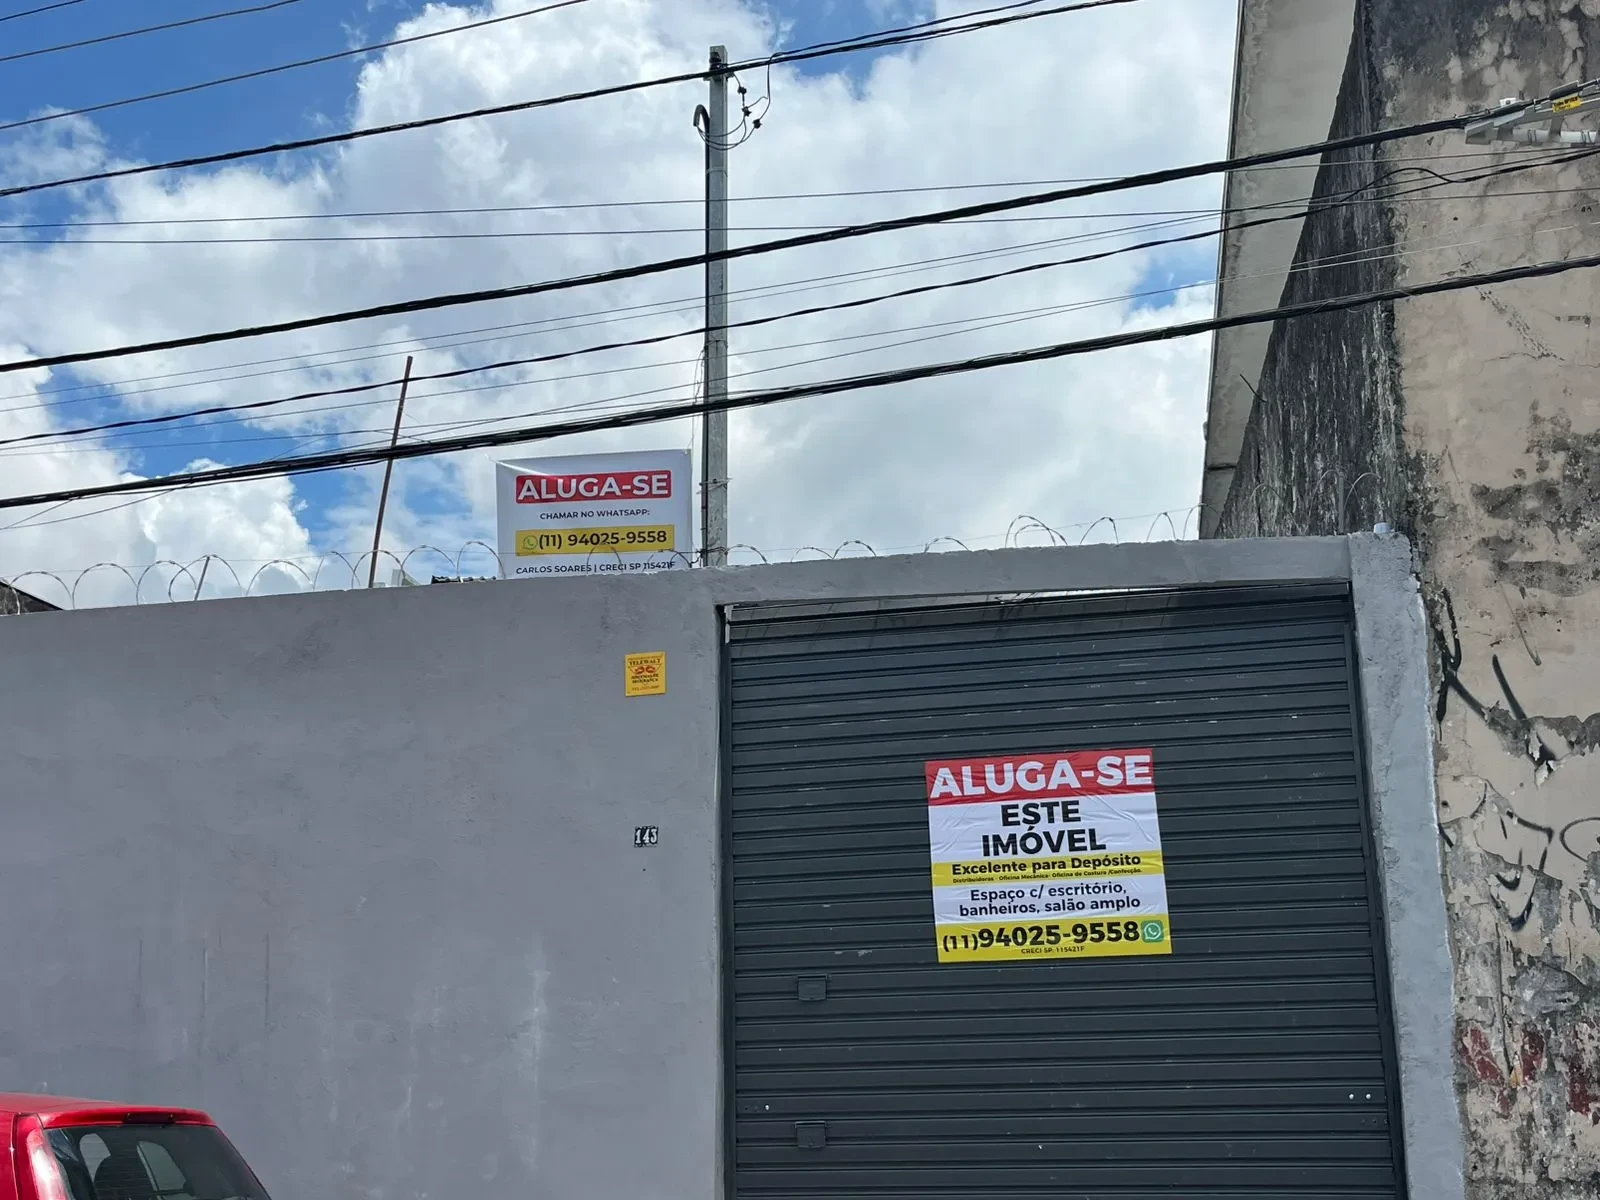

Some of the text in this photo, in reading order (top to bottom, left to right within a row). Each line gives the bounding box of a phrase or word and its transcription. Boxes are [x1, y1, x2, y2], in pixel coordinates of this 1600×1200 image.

[518, 474, 668, 500] ALUGA-SE
[540, 508, 650, 520] CHAMAR NO WHATSAPP:
[539, 530, 667, 550] (11) 94025-9558
[516, 565, 552, 574] CARLOS
[554, 564, 592, 573] SOARES
[599, 562, 627, 572] CRECI
[629, 562, 641, 570] SP
[930, 754, 1153, 799] ALUGA-SE
[1001, 800, 1081, 827] ESTE
[982, 825, 1106, 857] IMÓVEL
[952, 853, 1141, 876] Excelente para Depósito
[970, 881, 1126, 903] Espaço c/ escritório,
[960, 895, 1141, 917] banheiros, salão amplo
[1056, 945, 1085, 953] 115421F
